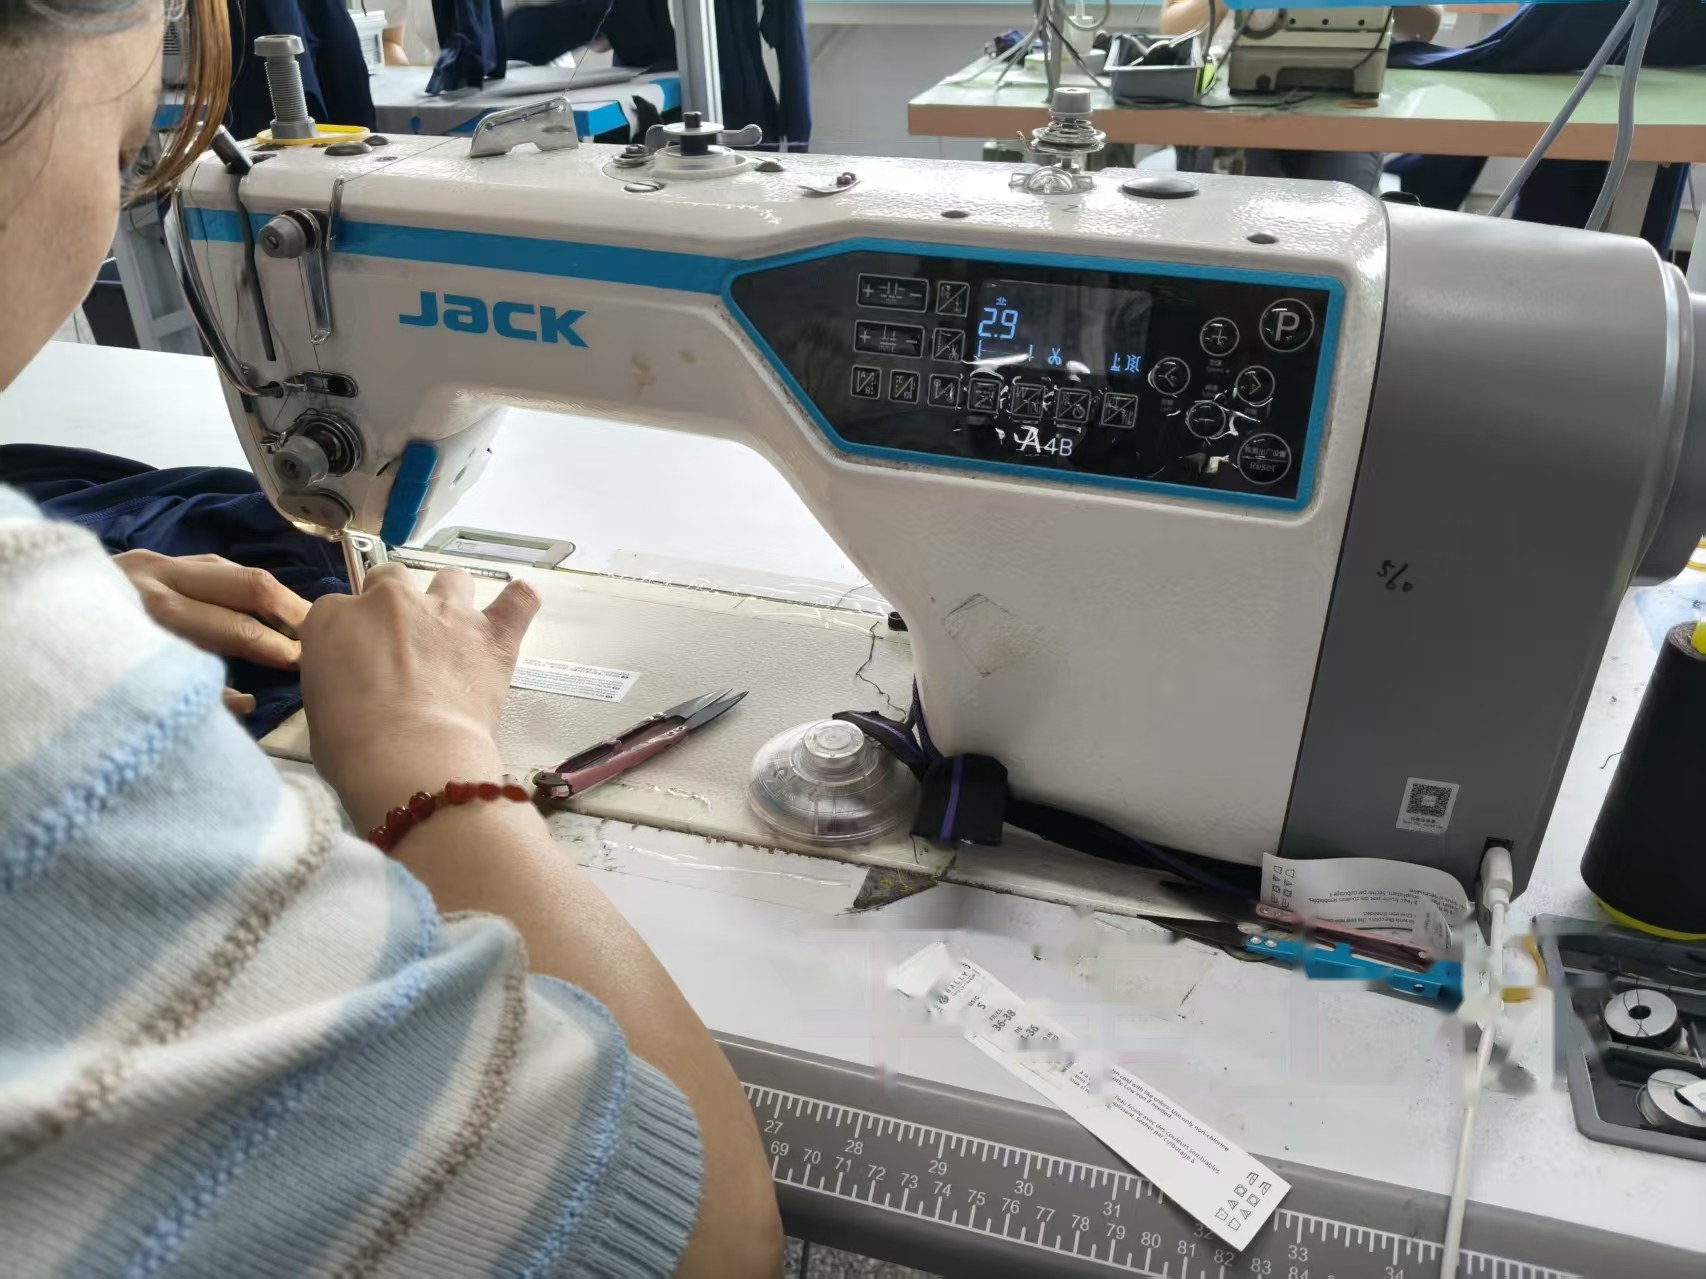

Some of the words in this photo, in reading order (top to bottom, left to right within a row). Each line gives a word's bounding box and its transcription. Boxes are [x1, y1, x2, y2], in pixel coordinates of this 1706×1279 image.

[978, 307, 1018, 339] 2.9
[1275, 311, 1300, 342] P
[992, 1009, 1017, 1032] 36-38
[763, 1120, 783, 1135] 27
[844, 1139, 864, 1156] 28
[927, 1159, 948, 1176] 29
[1013, 1180, 1034, 1197] 30
[1102, 1202, 1121, 1219] 31
[1287, 1245, 1309, 1262] 33
[770, 1140, 790, 1157] 69
[802, 1149, 821, 1164] 70
[834, 1156, 852, 1173] 71
[867, 1164, 887, 1181] 72
[900, 1172, 919, 1189] 73
[933, 1181, 952, 1197] 74
[967, 1189, 987, 1206] 75
[1001, 1198, 1020, 1215] 76
[1035, 1206, 1055, 1223] 77
[1071, 1214, 1090, 1232] 78
[1106, 1223, 1126, 1240] 79
[1141, 1231, 1161, 1249] 80
[1177, 1240, 1196, 1257] 81
[1214, 1249, 1235, 1266] 82
[1251, 1258, 1271, 1275] 83
